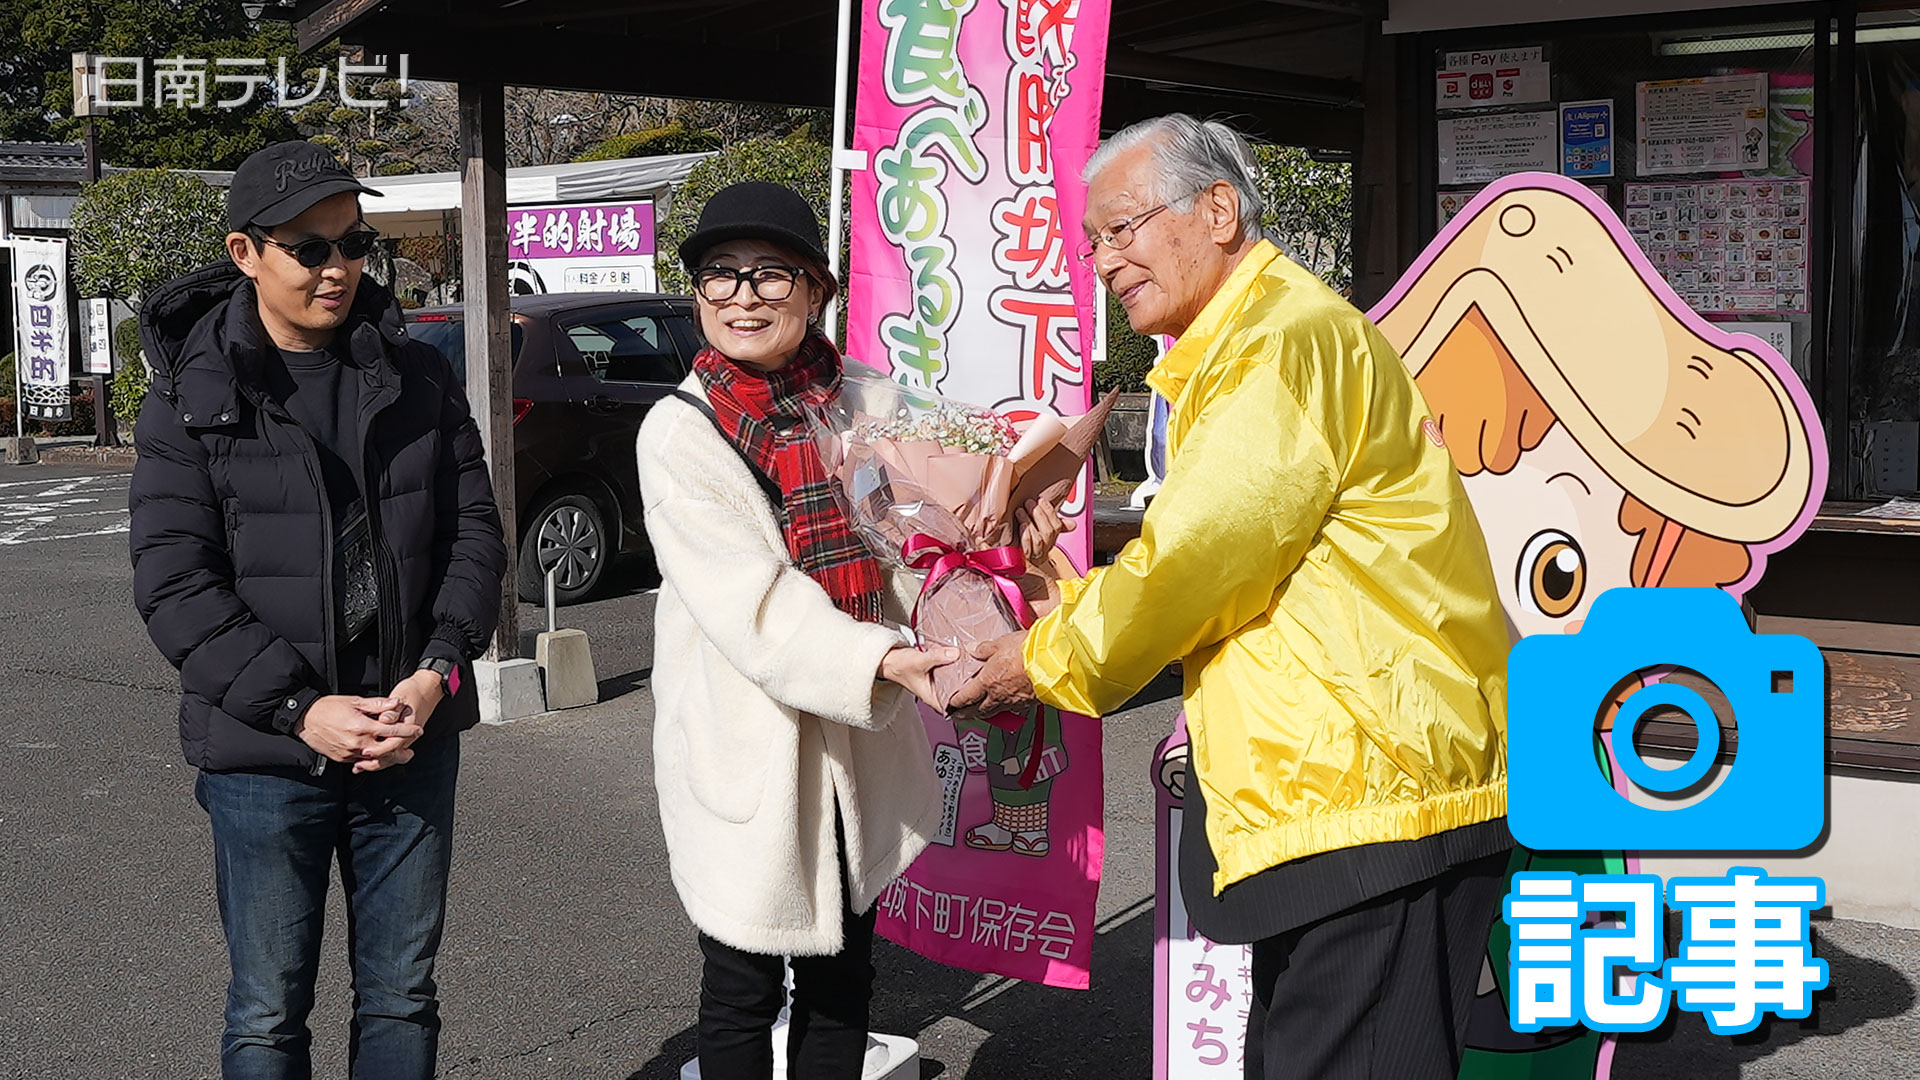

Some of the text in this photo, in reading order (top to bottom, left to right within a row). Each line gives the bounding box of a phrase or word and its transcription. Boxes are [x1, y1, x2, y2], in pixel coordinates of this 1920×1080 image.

[1472, 53, 1496, 66] Pay
[507, 206, 641, 255] 半的射場
[959, 731, 988, 769] 食
